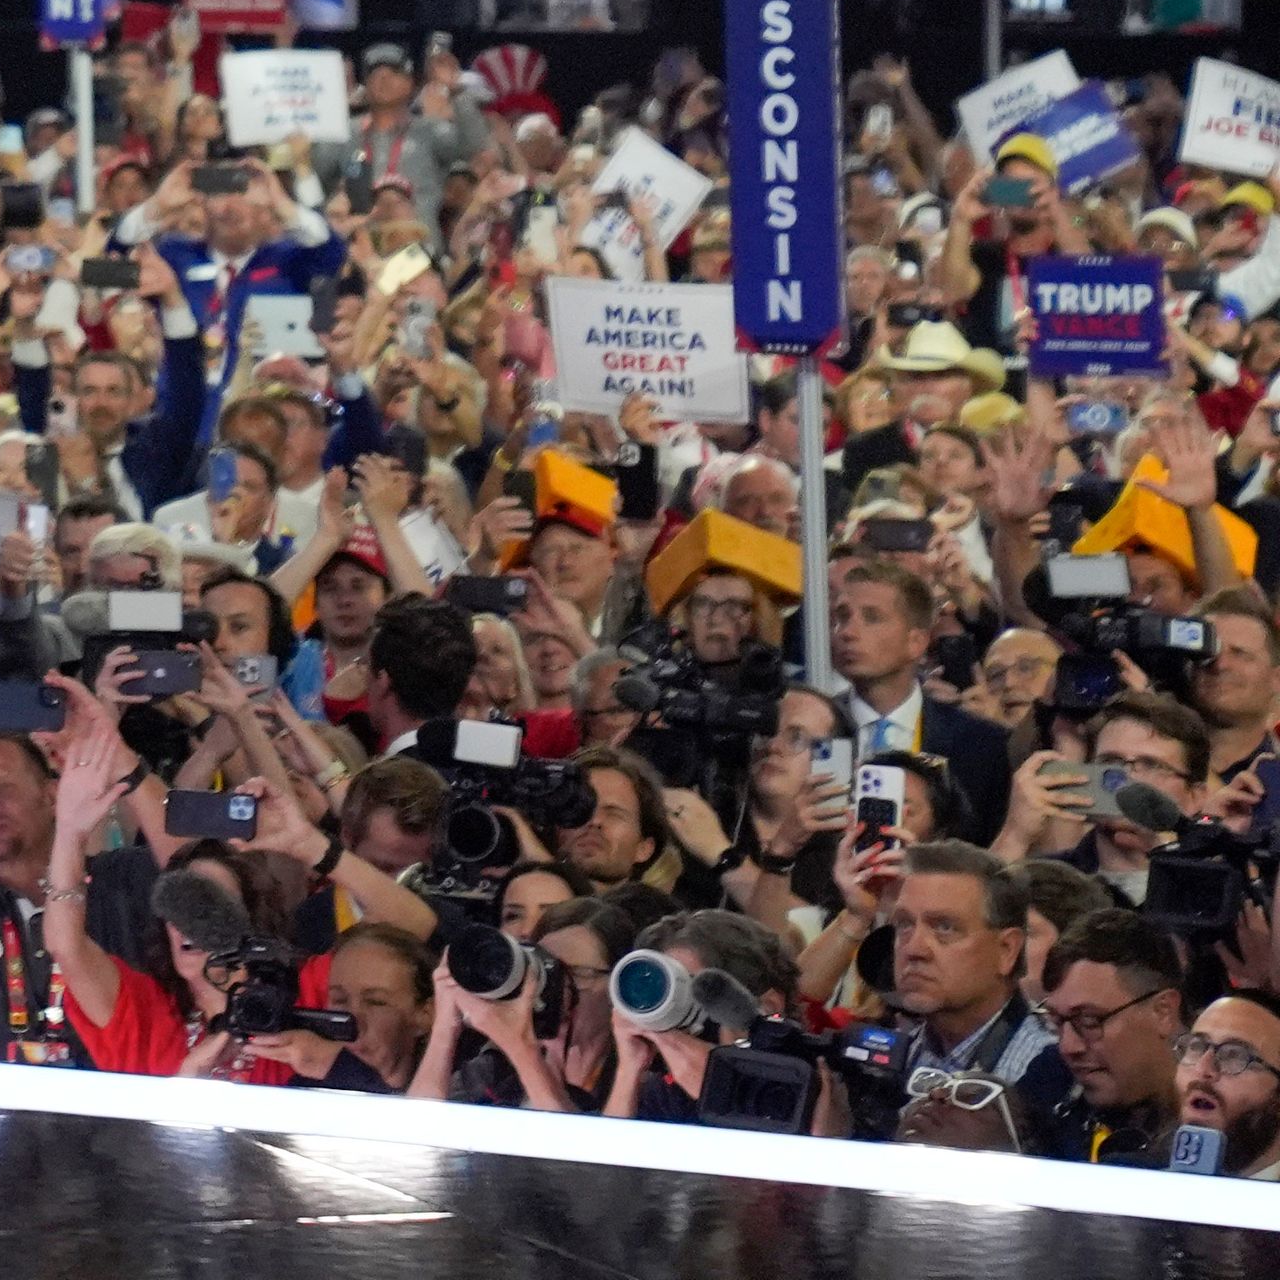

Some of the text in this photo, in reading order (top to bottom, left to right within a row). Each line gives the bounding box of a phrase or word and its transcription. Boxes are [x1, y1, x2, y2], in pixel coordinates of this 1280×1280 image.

[1035, 283, 1156, 315] TRUMP
[604, 304, 682, 327] MAKE
[1049, 315, 1142, 337] VANCE
[585, 327, 707, 352] AMERICA
[602, 350, 690, 374] GREAT
[602, 375, 696, 399] AGAIN!
